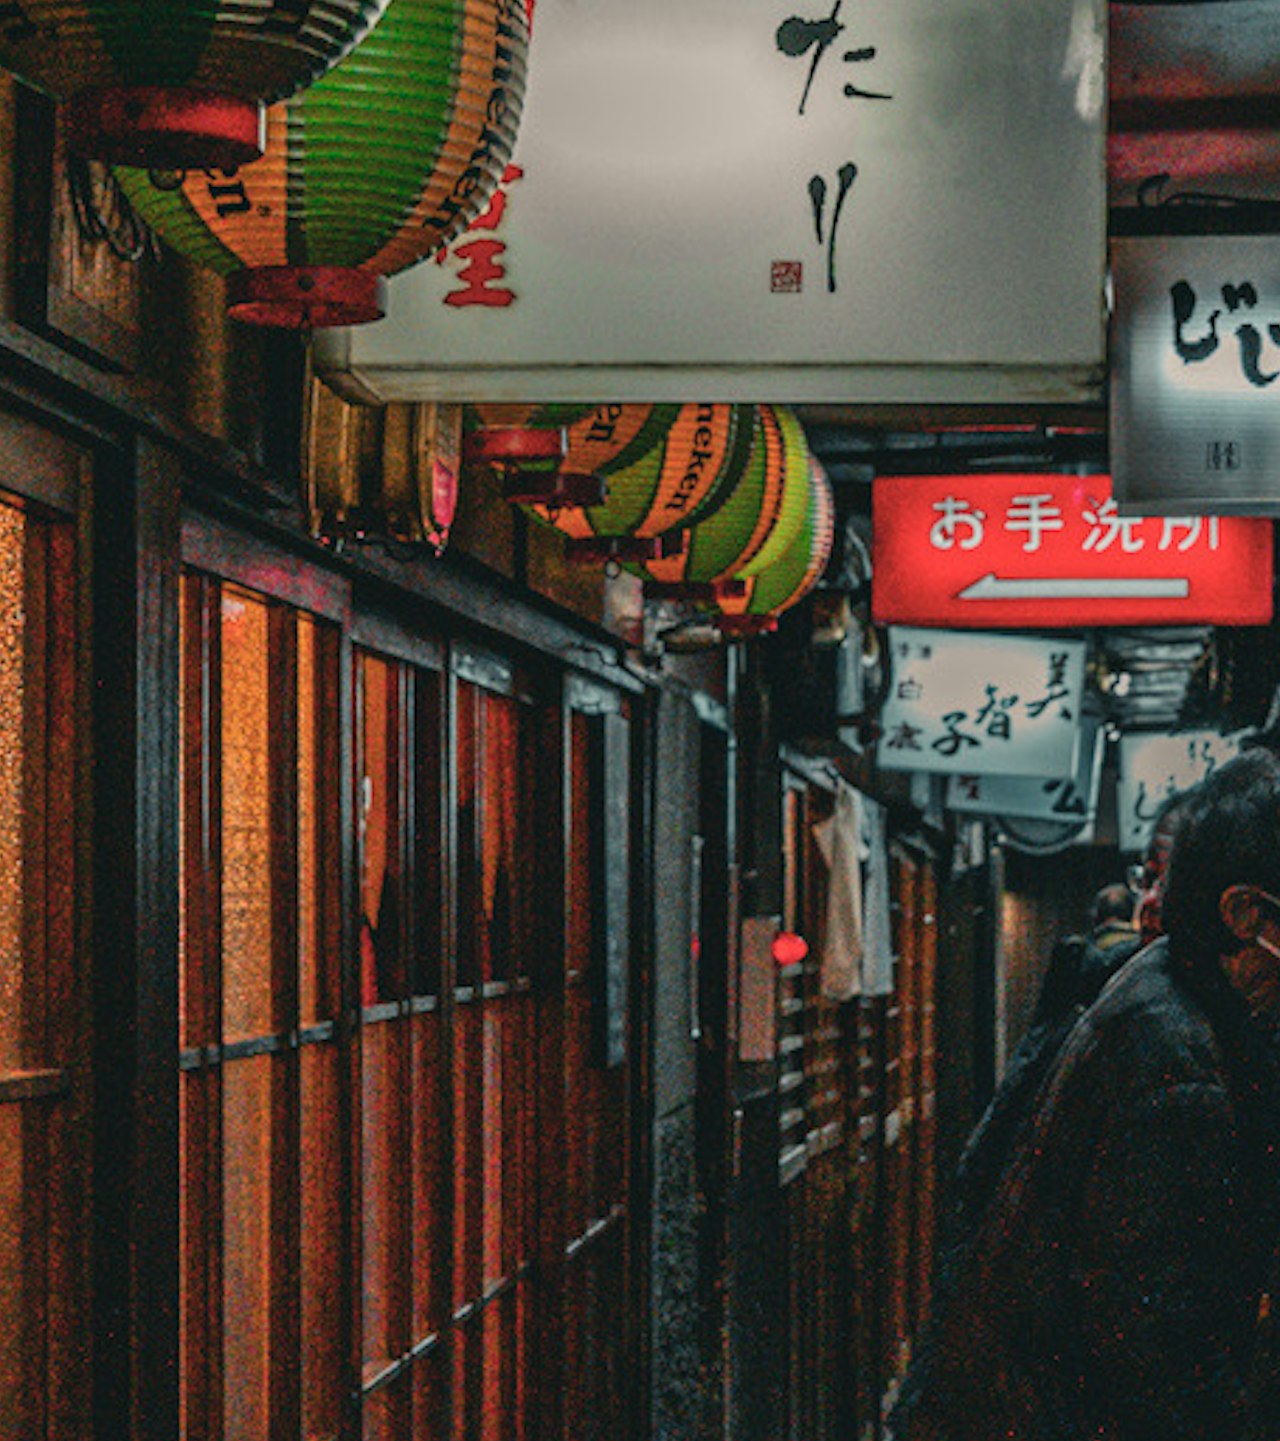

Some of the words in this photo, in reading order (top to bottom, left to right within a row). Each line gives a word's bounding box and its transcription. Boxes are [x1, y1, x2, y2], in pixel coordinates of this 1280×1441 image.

[665, 403, 714, 509] neken
[932, 652, 1074, 755] 美智子
